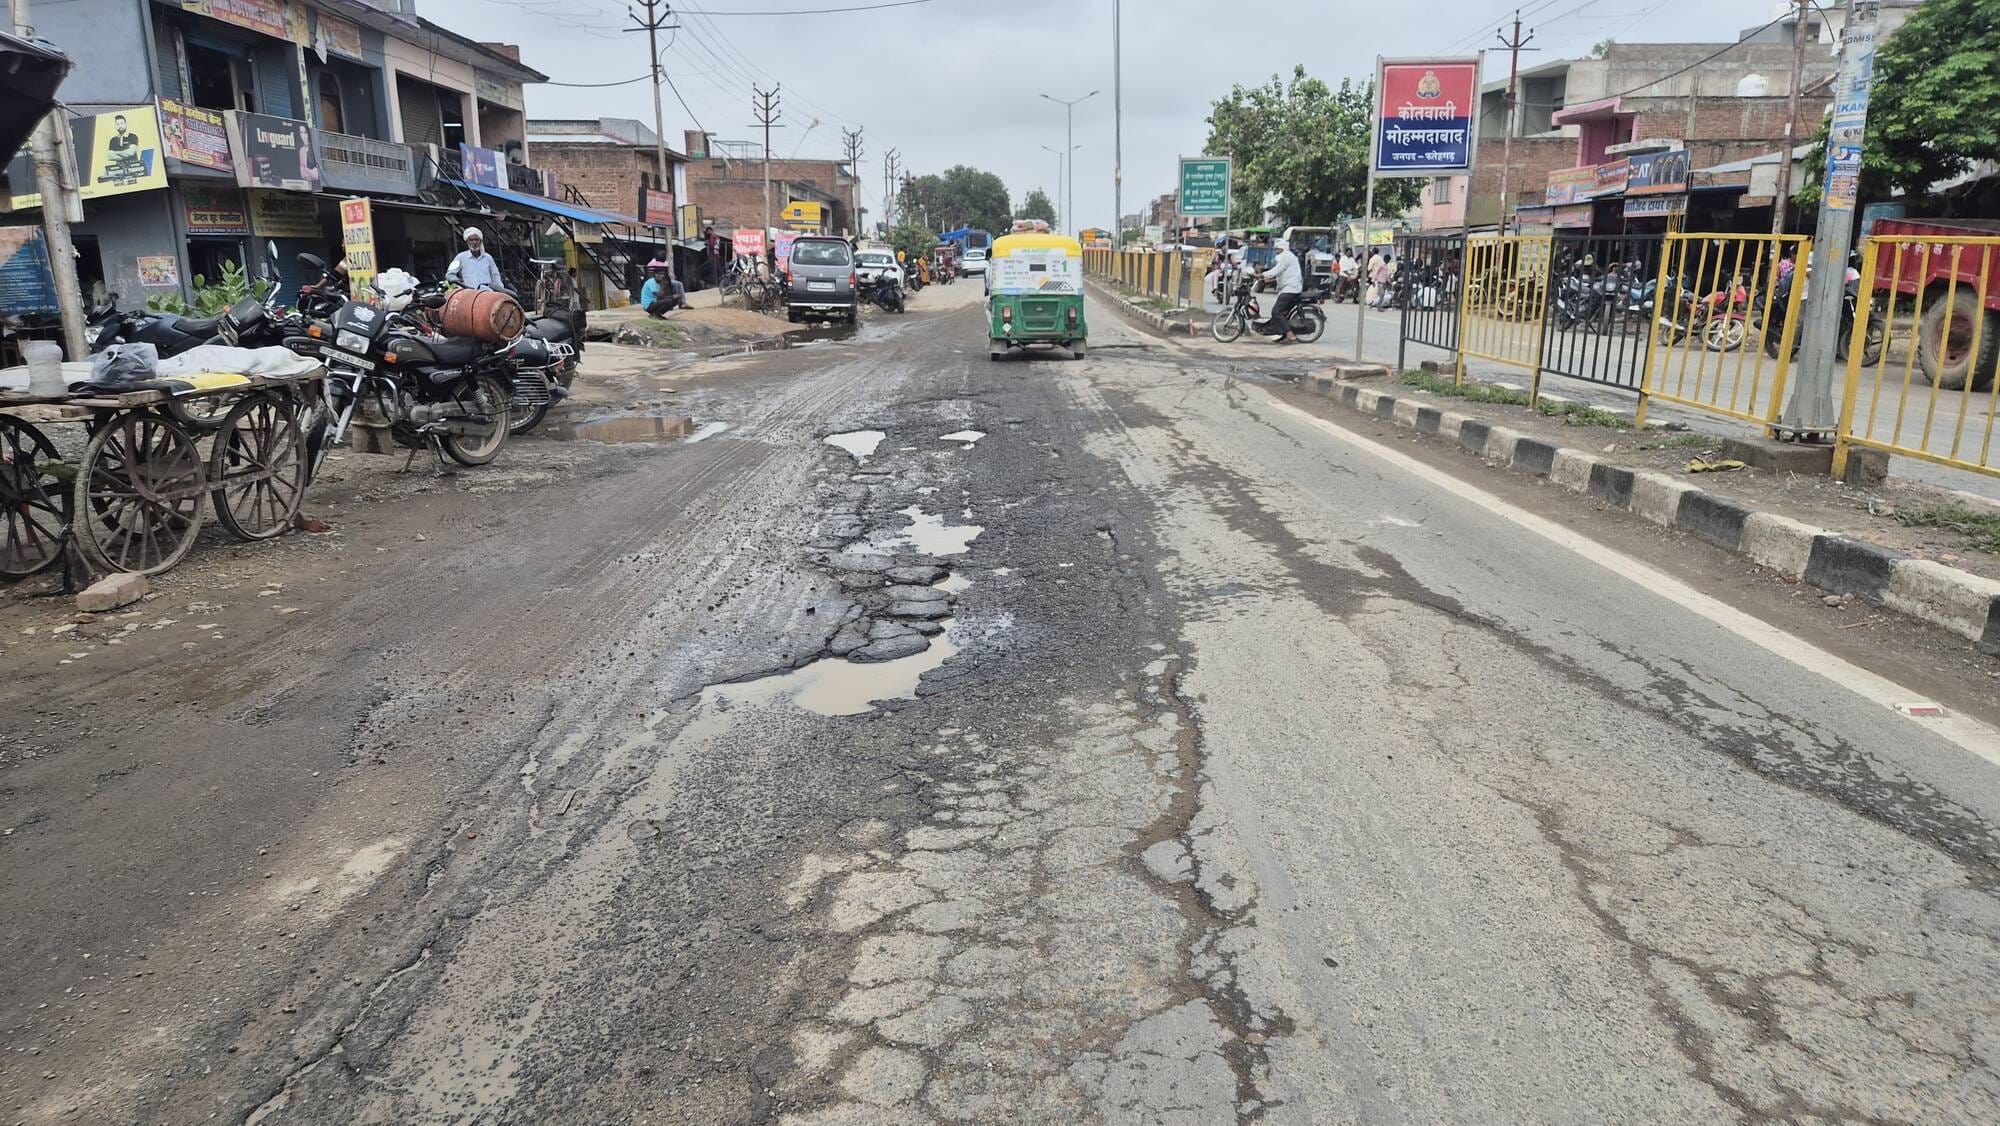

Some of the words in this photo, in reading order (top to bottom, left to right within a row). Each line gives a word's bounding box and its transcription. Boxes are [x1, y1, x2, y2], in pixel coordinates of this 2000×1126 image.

[1397, 100, 1456, 120] कोतवाली
[1386, 125, 1465, 146] मोहम्मदाबाद
[1392, 152, 1417, 161] जनपद
[1628, 162, 1650, 180] CEAT
[1648, 199, 1666, 212] टायर
[348, 250, 373, 270] SALON
